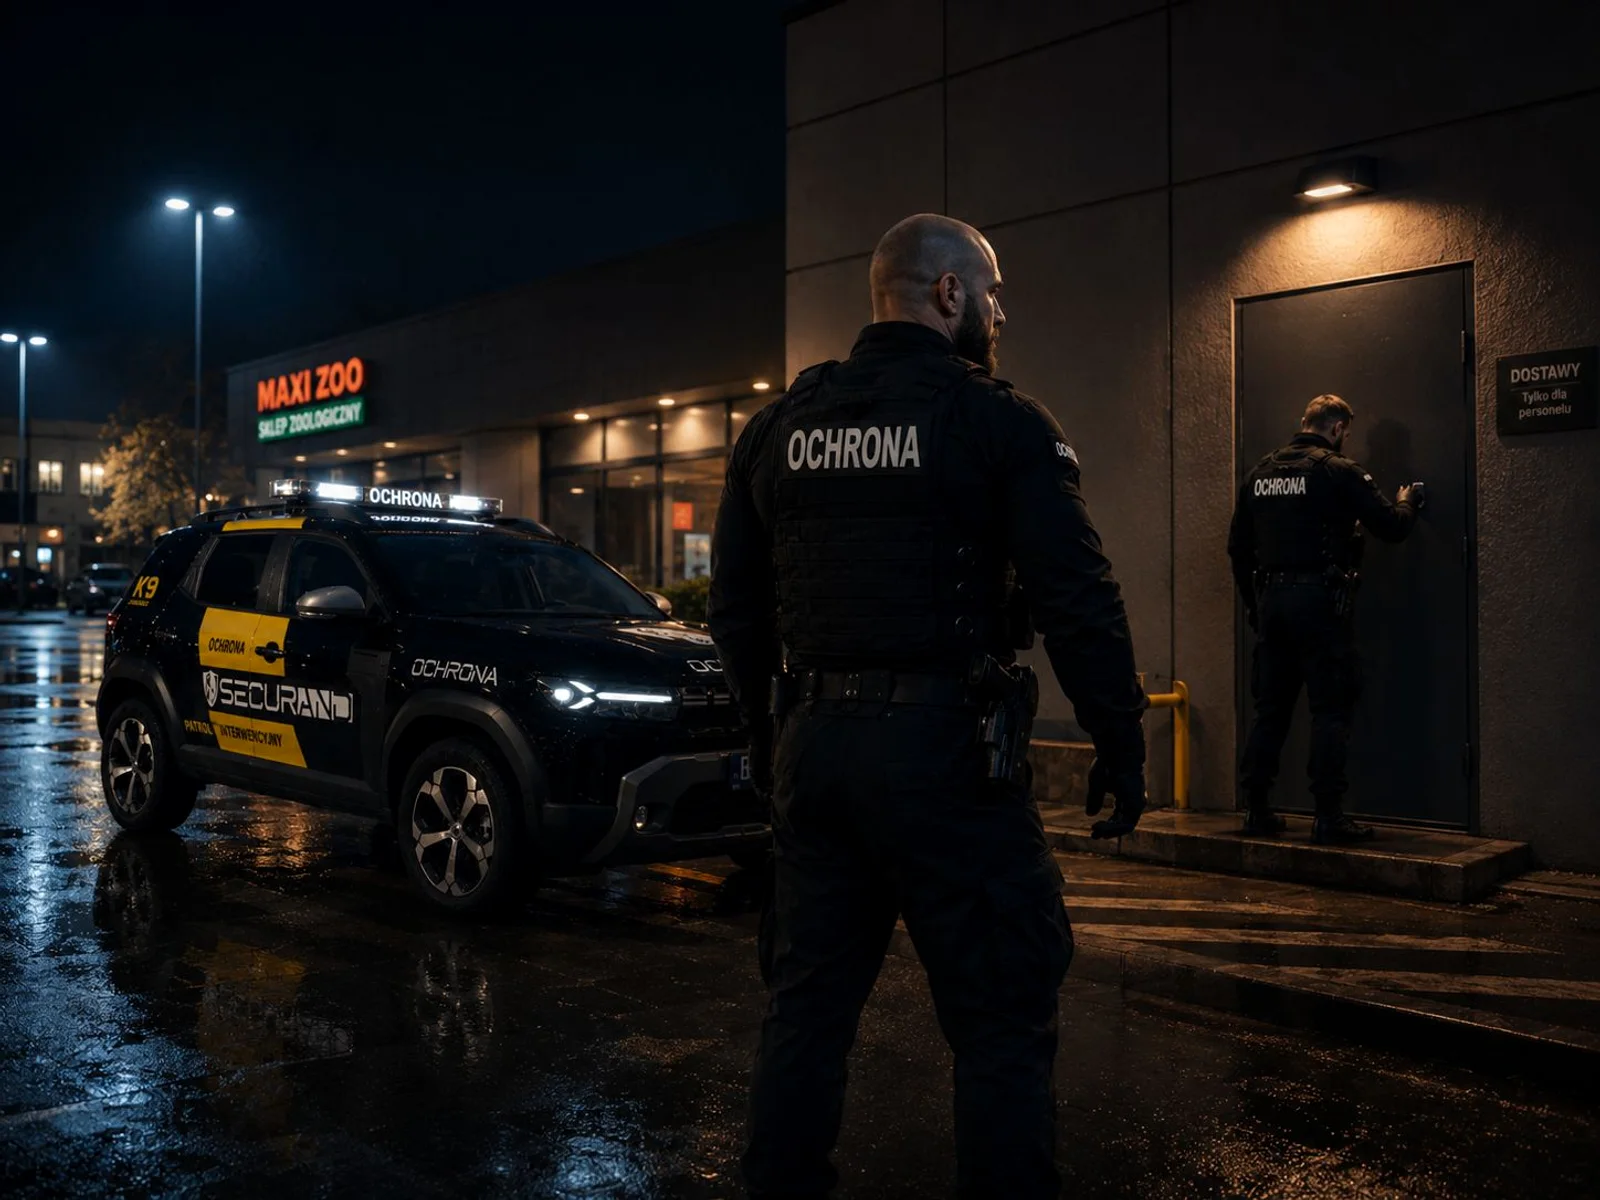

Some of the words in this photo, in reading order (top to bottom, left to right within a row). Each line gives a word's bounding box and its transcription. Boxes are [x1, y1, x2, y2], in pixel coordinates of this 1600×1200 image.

[1510, 362, 1581, 384] DOSTAWY
[257, 368, 311, 413] MAXI
[315, 356, 365, 400] ZOO
[1521, 390, 1549, 405] Tylko
[1551, 388, 1568, 400] dla
[258, 416, 288, 440] SKLEP
[289, 401, 362, 434] ZOOLOGICZNY
[1518, 402, 1572, 420] personelu
[787, 425, 921, 471] OCHRONA
[1254, 476, 1307, 496] OCHRONA
[369, 487, 443, 509] OCHRONA
[132, 575, 160, 599] K9
[208, 636, 246, 655] OCHRONA
[411, 658, 498, 687] OCHRONA
[686, 659, 724, 672] OC
